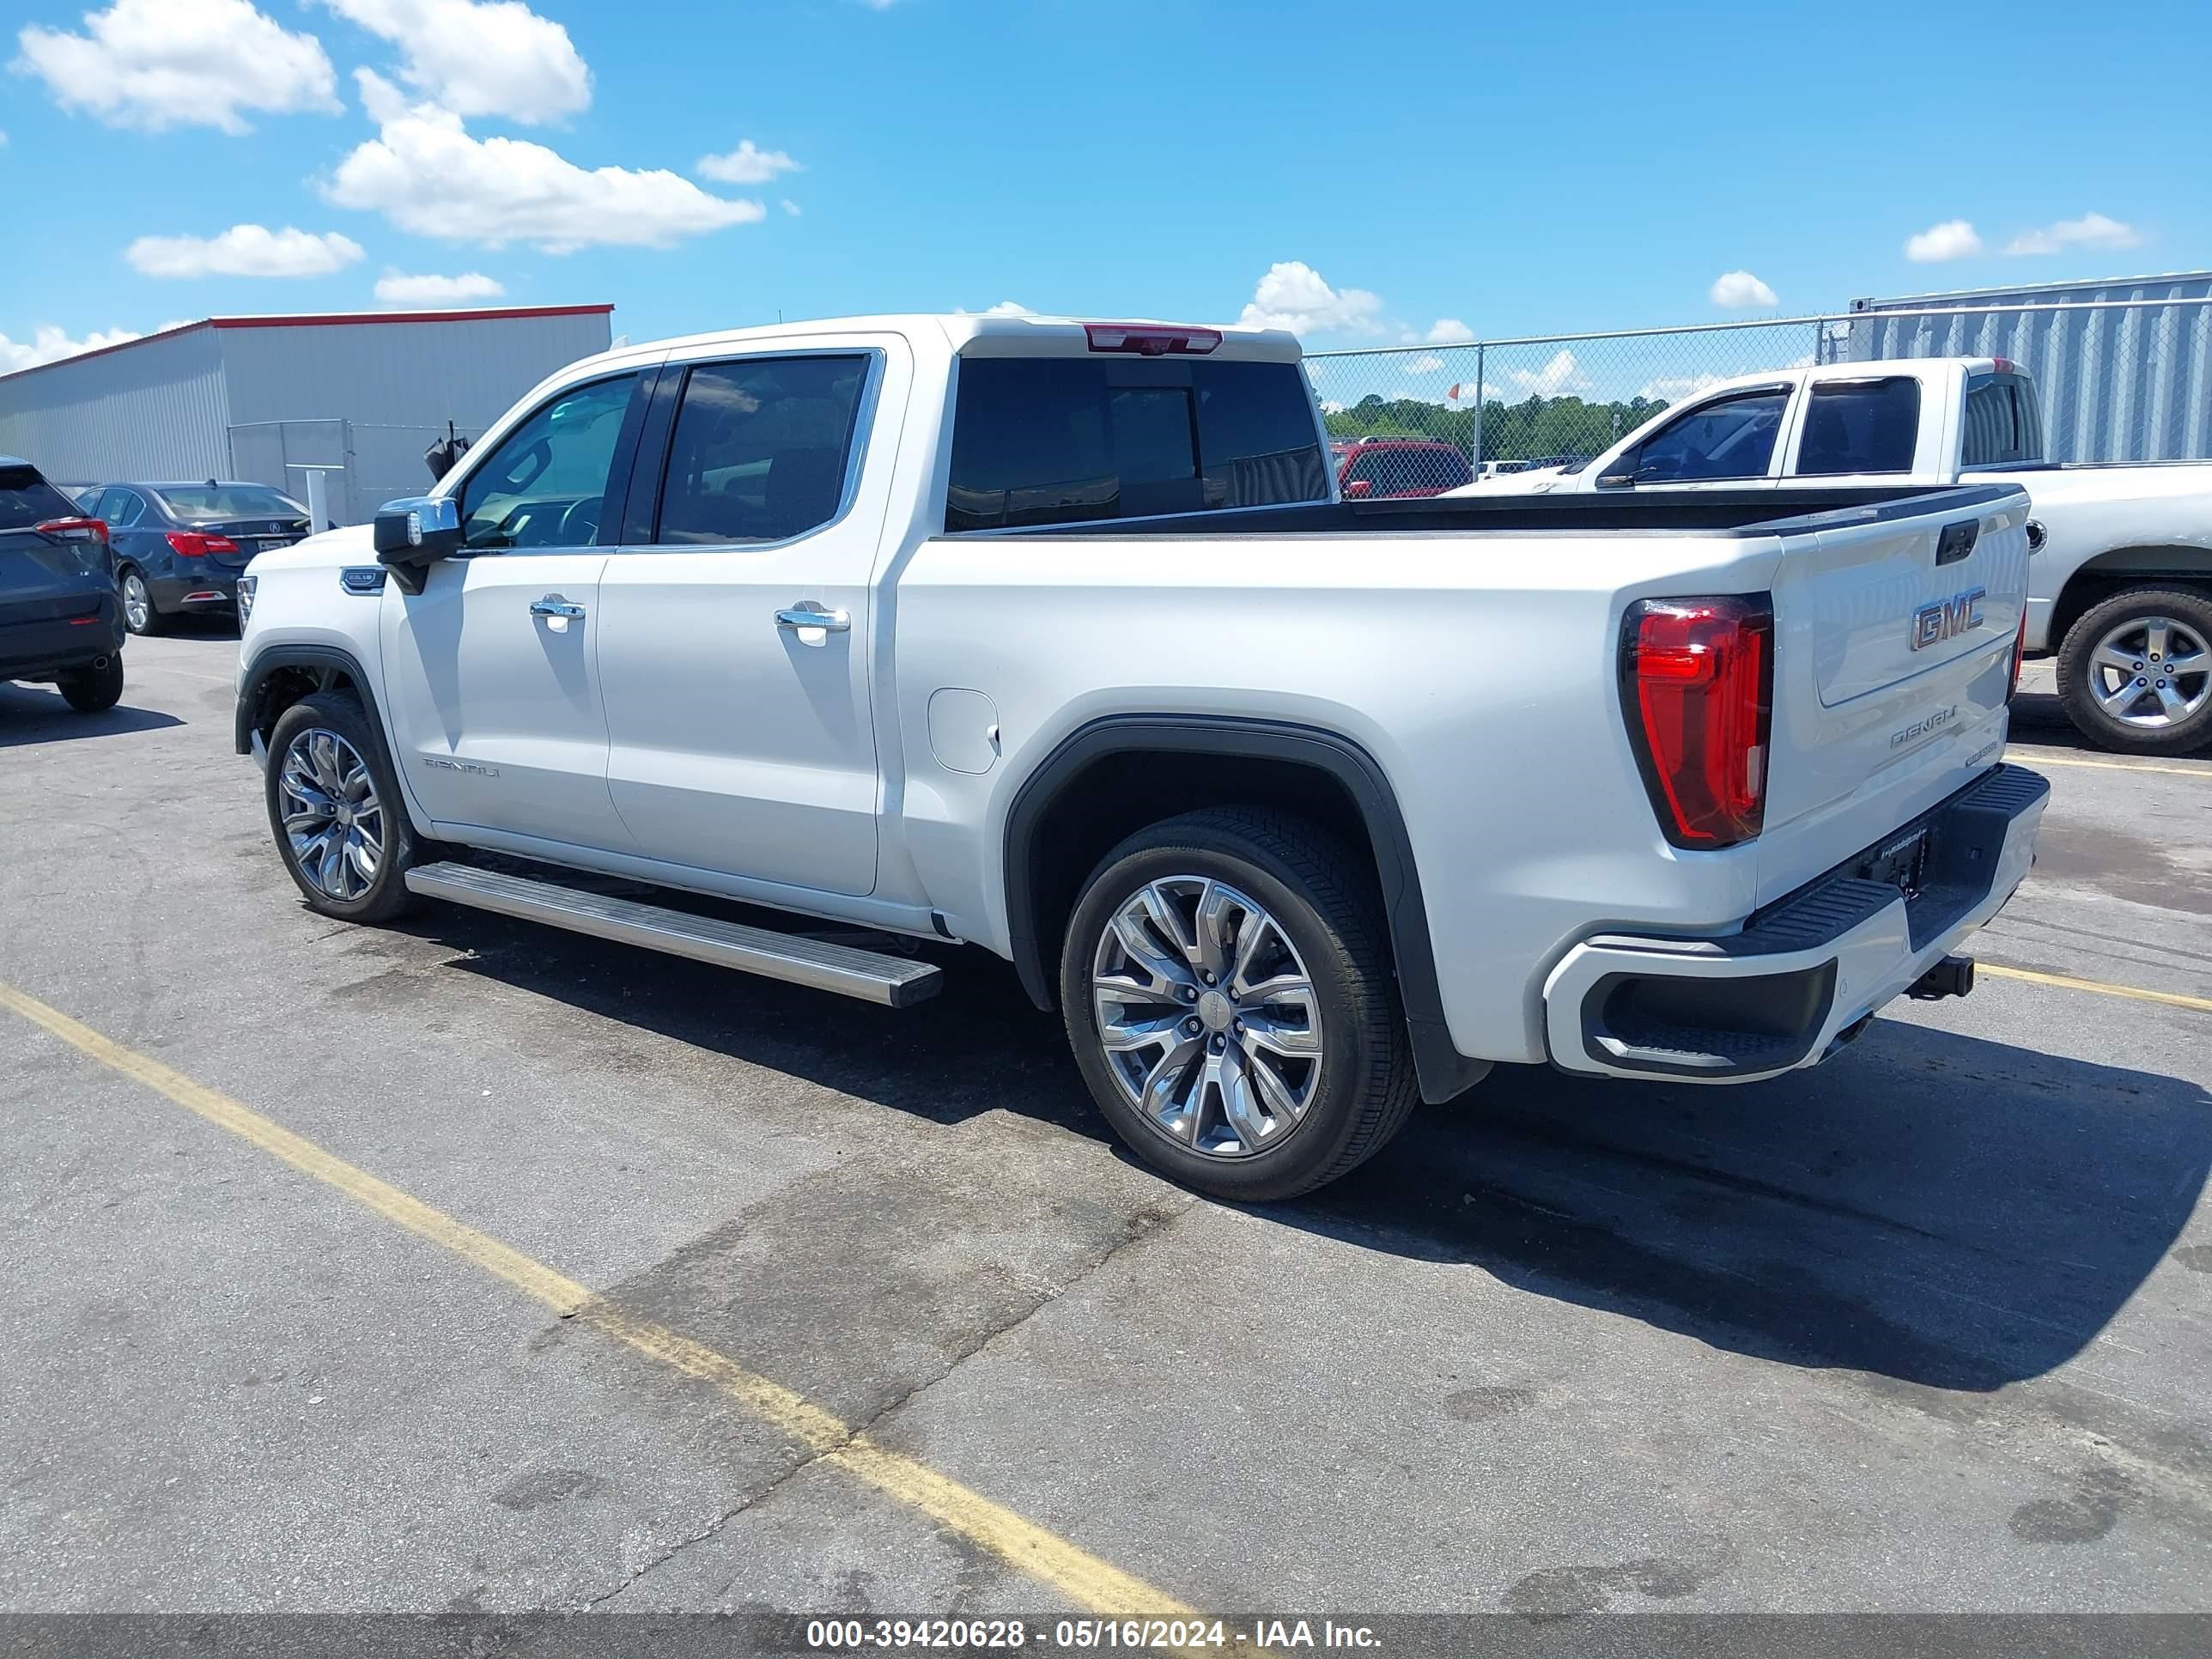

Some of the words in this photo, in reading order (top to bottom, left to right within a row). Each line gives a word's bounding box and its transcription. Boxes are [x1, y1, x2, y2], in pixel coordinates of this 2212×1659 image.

[1911, 586, 1986, 652] GMC
[1890, 704, 1957, 750] DENALI
[422, 757, 500, 778] DENALI
